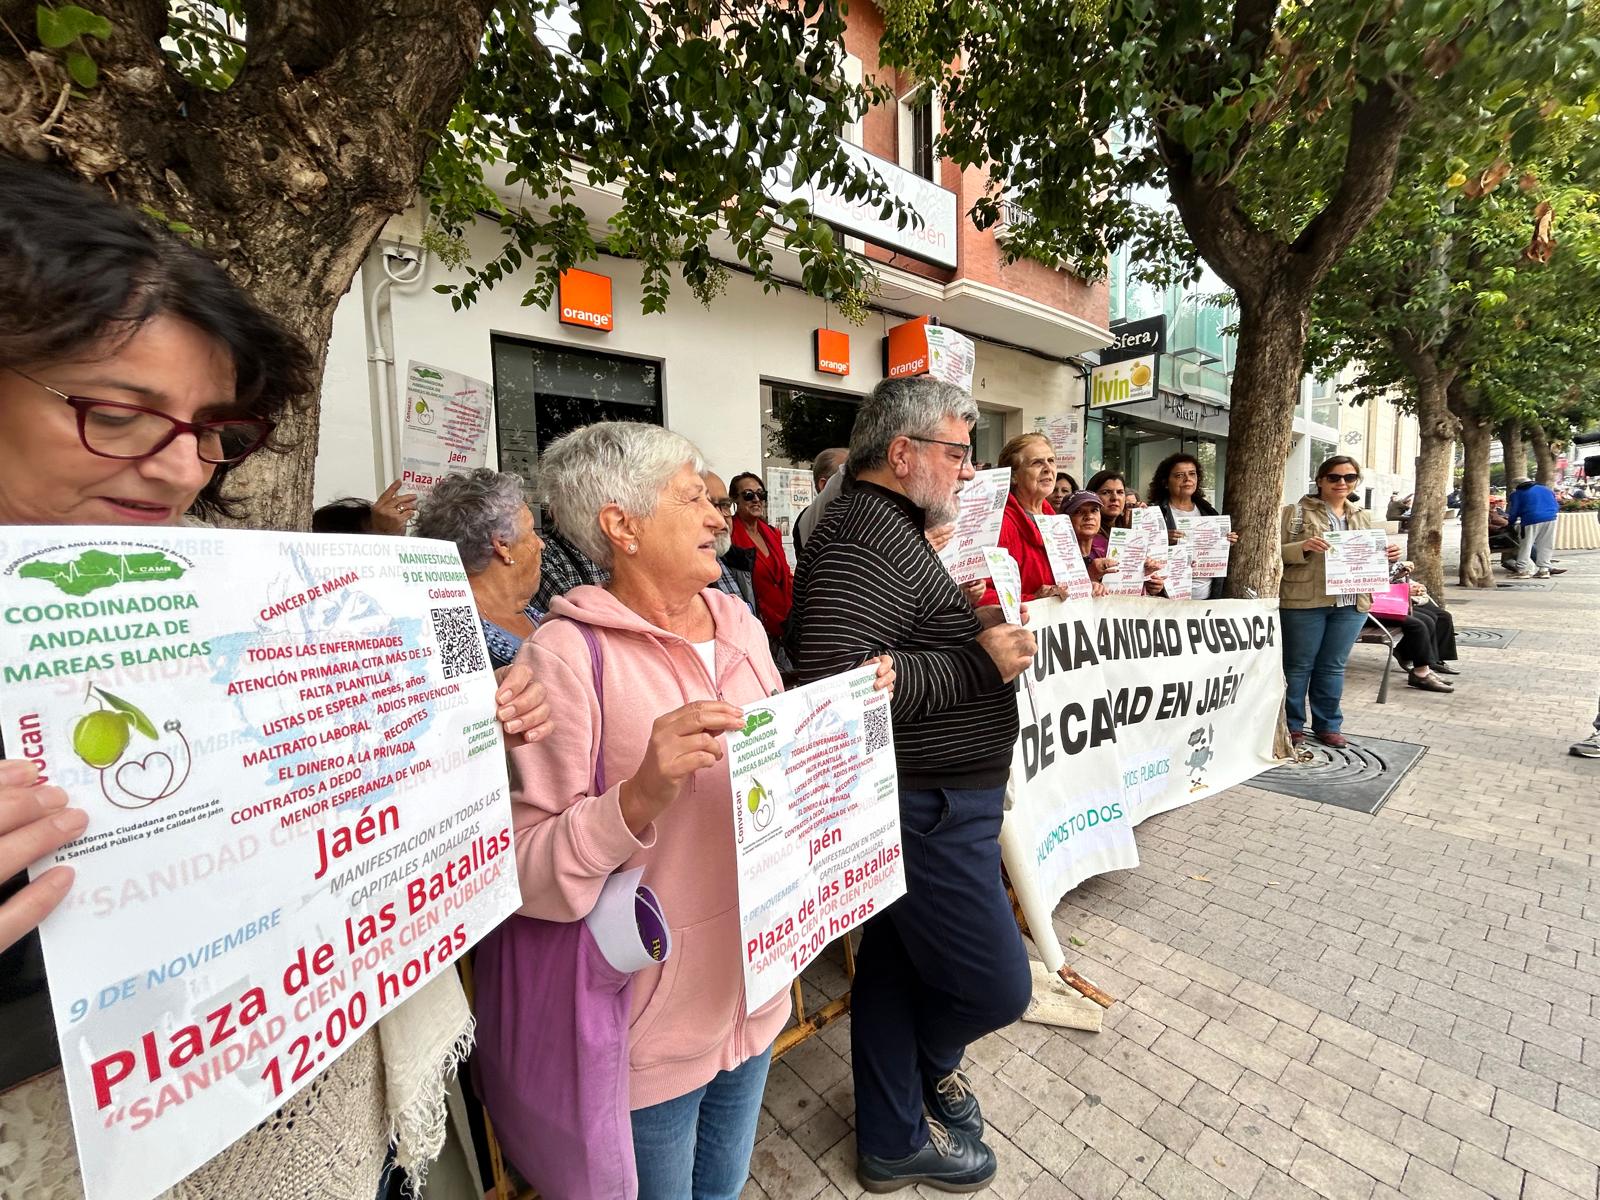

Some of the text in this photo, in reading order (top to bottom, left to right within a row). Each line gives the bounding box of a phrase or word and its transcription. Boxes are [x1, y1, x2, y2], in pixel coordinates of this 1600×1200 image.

[564, 308, 608, 325] orange
[821, 360, 847, 371] orange
[891, 359, 924, 376] orange
[981, 378, 985, 388] 4
[1093, 370, 1129, 405] livin
[448, 451, 467, 463] Jaén
[403, 470, 432, 485] Plaza
[3, 544, 65, 576] COORDINADORA
[67, 540, 119, 549] ANDALUZA
[135, 542, 169, 553] MAREAS
[170, 550, 196, 568] BLANCAS
[399, 552, 461, 566] MANIFESTACIÓN
[402, 570, 468, 583] 9 DE NOVIEMBRE
[4, 593, 199, 624] COORDINADORA
[260, 571, 359, 622] CANCER DE MAMA
[428, 587, 466, 600] Colaboran
[28, 619, 189, 652] ANDALUZA DE
[247, 636, 403, 663] TODAS LAS ENFERMEDADES
[1034, 620, 1099, 682] UNA
[1097, 617, 1182, 661] ANIDAD
[1187, 609, 1274, 654] PÚBLICA
[4, 652, 115, 683] MAREAS
[121, 641, 212, 667] BLANCAS
[227, 670, 298, 696] ATENCIÓN
[300, 661, 360, 682] PRIMARIA
[361, 655, 384, 672] CITA
[386, 649, 407, 665] MÁS
[408, 649, 421, 661] DE
[422, 647, 432, 658] 15
[262, 675, 426, 737] LISTAS DE ESPERA meses, años
[299, 672, 392, 701] FALTA PLANTILLA
[376, 683, 460, 715] ADIOS PREVENCION
[242, 720, 371, 768] MALTRATO LABORAL
[384, 708, 428, 742] RECORTES
[462, 718, 488, 735] EN TODAS
[468, 728, 495, 745] CAPITALES
[732, 728, 778, 753] COORDINADORA
[1021, 713, 1055, 783] DE
[1155, 681, 1193, 721] EN
[1196, 666, 1244, 716] JAÉN
[278, 741, 416, 781] EL DINERO A LA PRIVADA
[467, 738, 498, 758] ANDALUZAS
[732, 751, 782, 779] MAREAS BLANCAS
[737, 740, 775, 764] ANDALUZA DE
[230, 768, 362, 825] CONTRATOS A DEDO
[280, 759, 432, 828] MENOR ESPERANZA DE VIDA
[55, 806, 224, 863] la Sanidad Pública y de Calidad de Jaén
[116, 815, 165, 835] Ciudadana
[178, 803, 210, 817] Defensa
[210, 799, 220, 807] de
[736, 791, 744, 844] Convocan
[1070, 802, 1123, 837] TODOS
[314, 804, 400, 880] Jaén
[329, 788, 501, 895] MANIFESTACION EN TODAS LAS
[808, 827, 842, 866] Jaén
[813, 820, 896, 873] MANIFESTACION TODAS LAS
[819, 839, 884, 881] CAPITALES ANDALUZAS
[351, 821, 480, 908] CAPITALES ANDALUZAS
[747, 844, 900, 963] Plaza de las Batallas
[750, 910, 759, 921] DE
[759, 879, 799, 913] NOVIEMBRE
[801, 916, 818, 937] CIEN
[820, 900, 838, 919] POR
[839, 886, 860, 906] CIEN
[790, 898, 875, 971] 12:00 horas
[69, 908, 282, 1024] 9 DE NOVIEMBRE
[91, 828, 510, 1111] Plaza de las Batallas
[293, 971, 347, 1022] CIEN
[351, 941, 394, 983] POR
[398, 910, 439, 951] CIEN
[259, 923, 467, 1100] 12:00 horas
